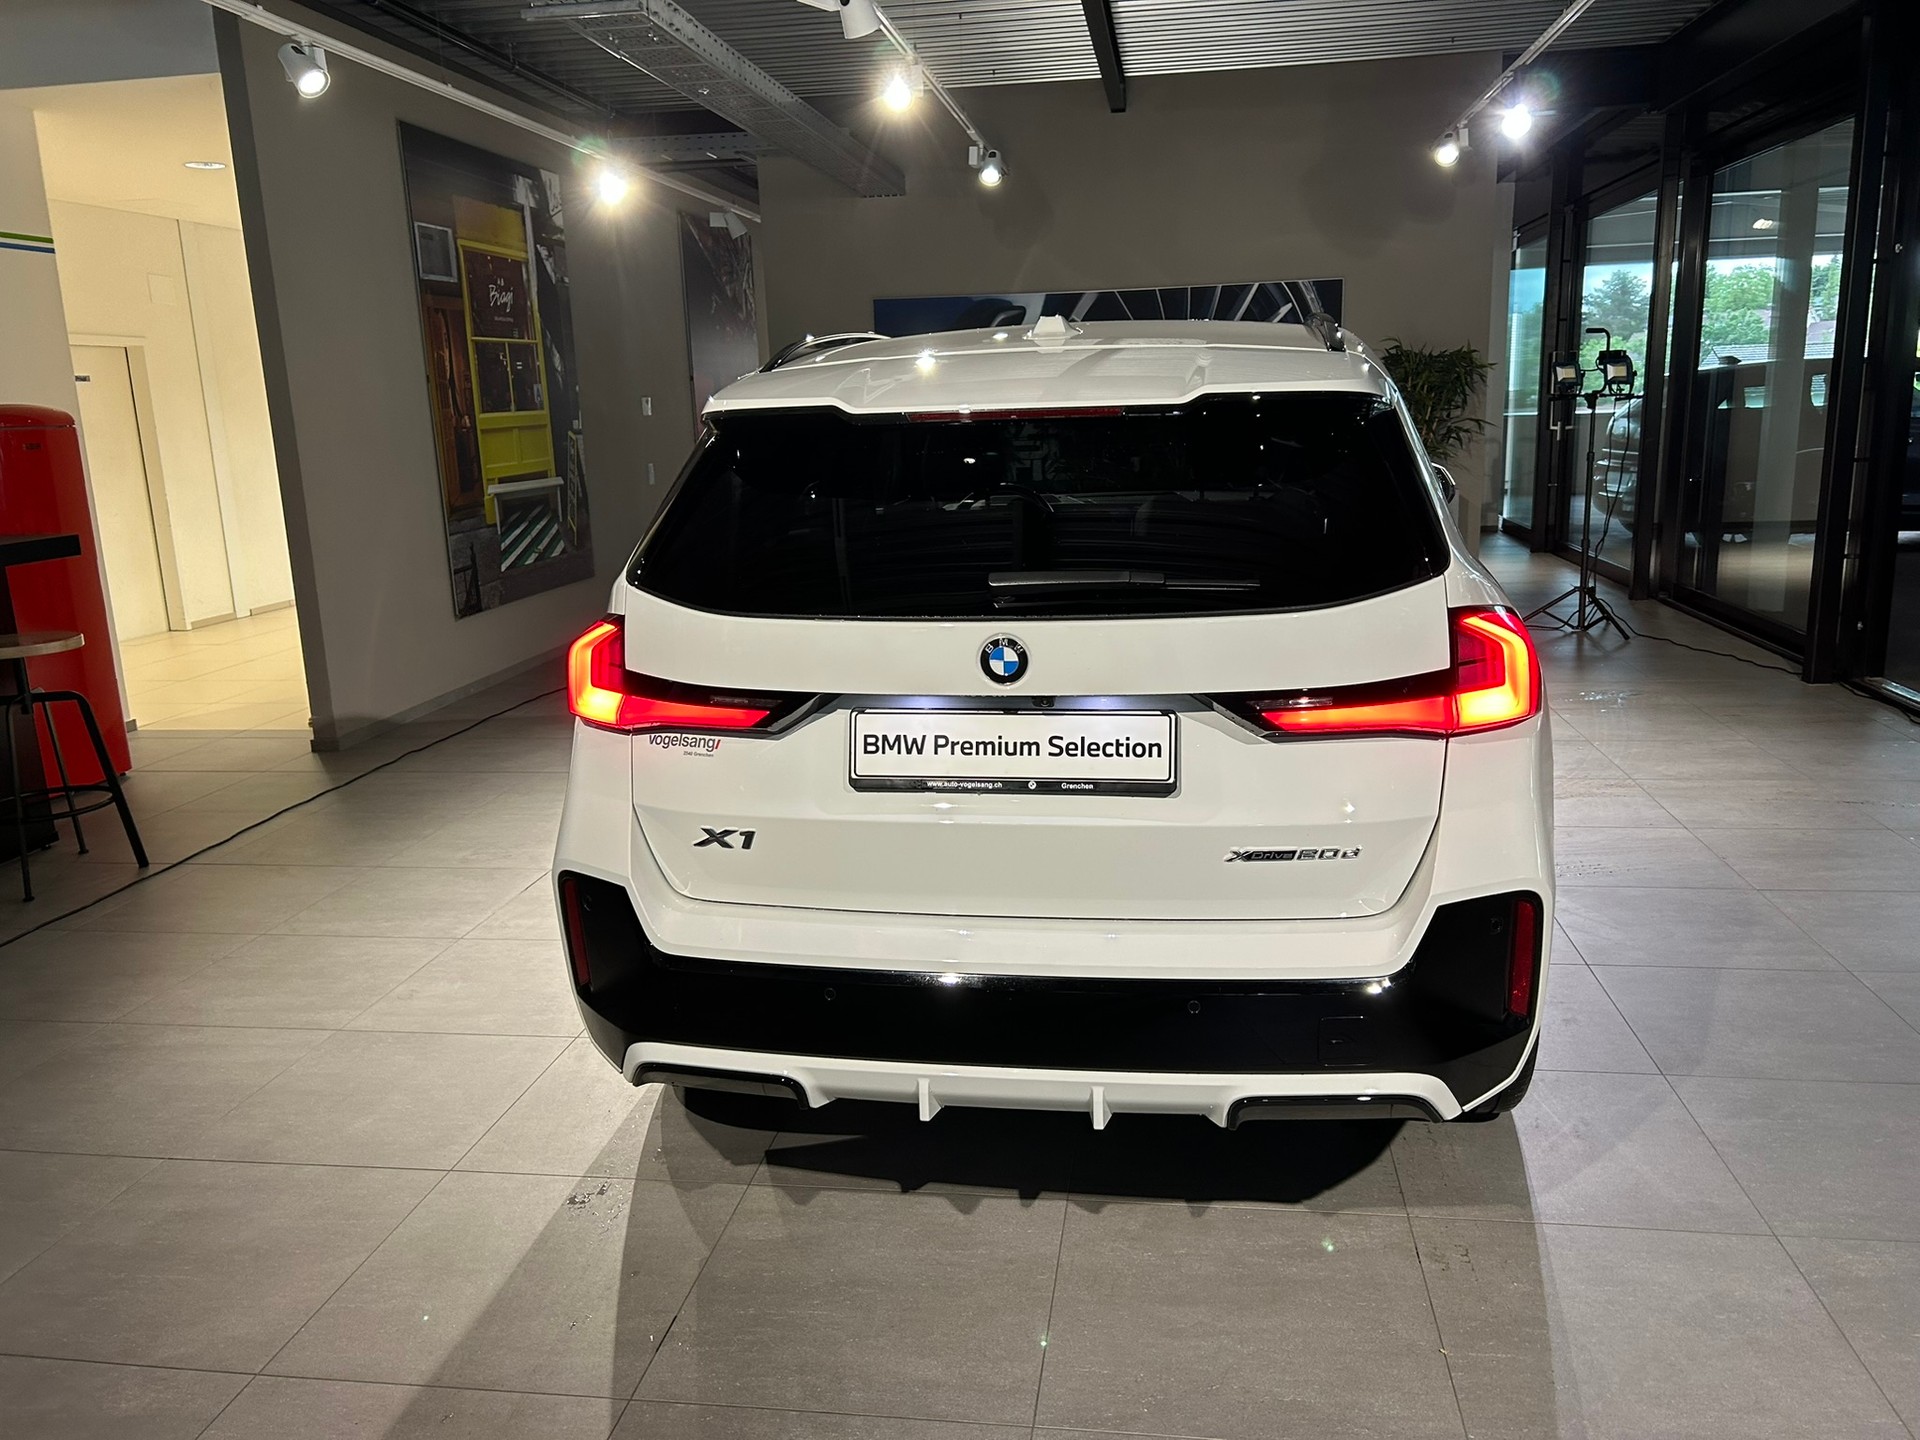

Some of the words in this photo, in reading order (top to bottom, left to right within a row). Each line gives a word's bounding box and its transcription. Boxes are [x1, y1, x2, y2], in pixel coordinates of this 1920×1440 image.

[985, 638, 1024, 654] BMW
[863, 734, 926, 755] BMW
[934, 735, 1040, 757] Premium
[1048, 736, 1162, 758] Selection
[926, 781, 1003, 791] www.auto-vogelsang.ch
[1061, 782, 1094, 791] Grenchen
[693, 826, 756, 850] X1
